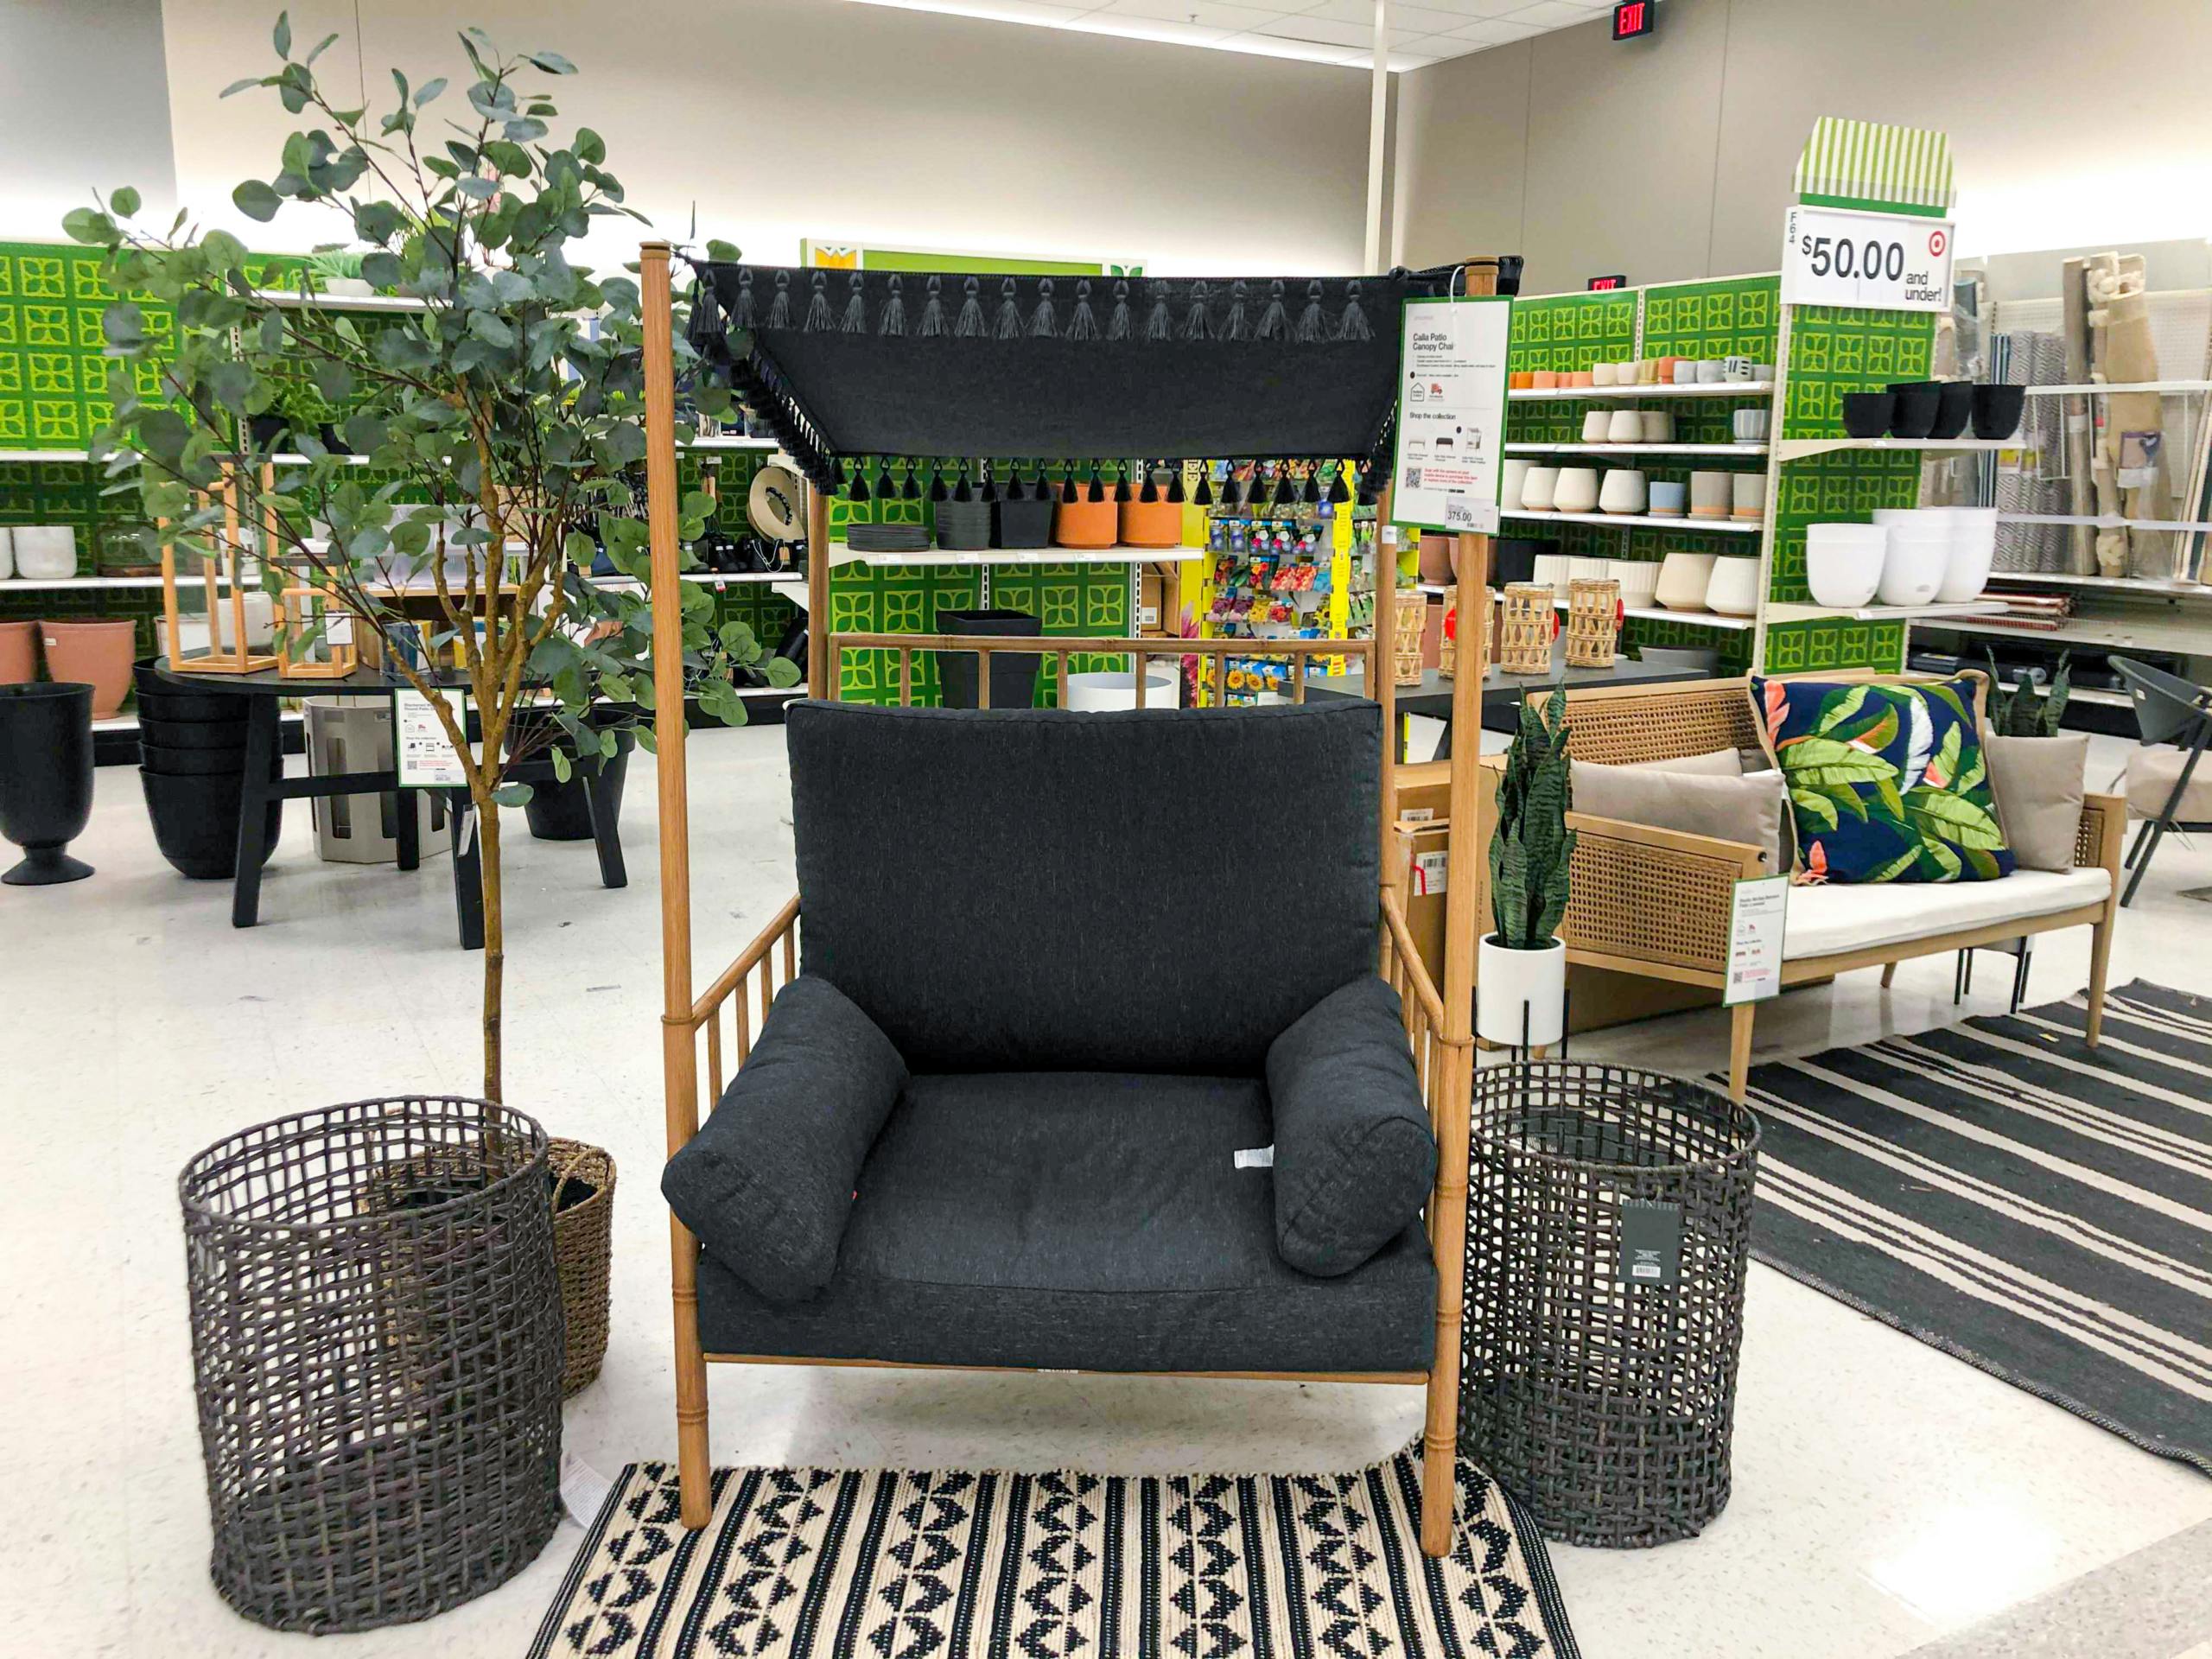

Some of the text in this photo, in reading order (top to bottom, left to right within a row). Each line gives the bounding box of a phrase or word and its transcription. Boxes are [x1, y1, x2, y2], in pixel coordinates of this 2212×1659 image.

[1618, 3, 1645, 35] EXIT
[1802, 233, 1904, 282] $50.00
[1906, 271, 1929, 285] and
[1592, 279, 1617, 291] EXIT
[1904, 287, 1942, 302] under!
[1430, 333, 1447, 341] Patio
[1412, 341, 1453, 353] Canopy Chai
[1409, 411, 1422, 421] Shop
[1447, 511, 1472, 522] 375.00
